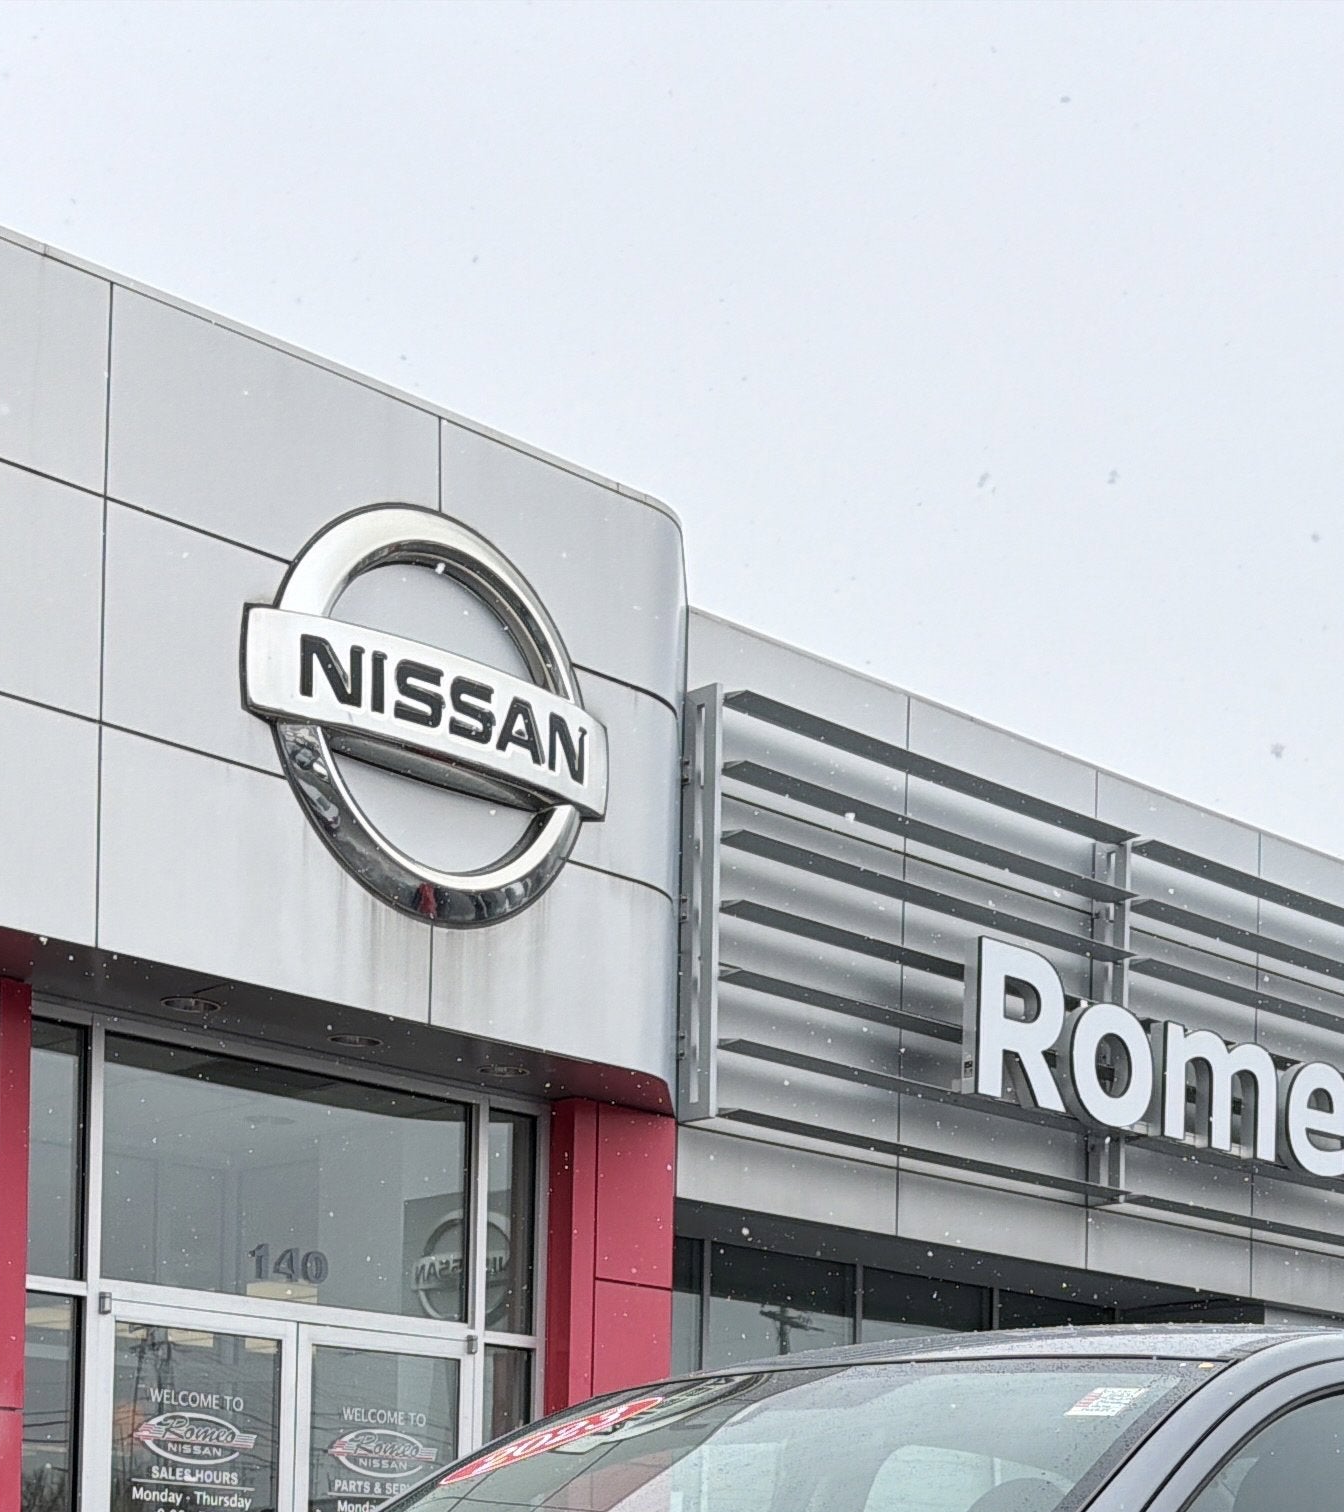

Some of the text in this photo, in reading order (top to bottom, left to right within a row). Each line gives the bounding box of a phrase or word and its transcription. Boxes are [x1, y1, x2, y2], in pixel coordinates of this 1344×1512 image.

[299, 633, 588, 786] NISSAN
[249, 1243, 329, 1285] 140
[149, 1387, 244, 1412] WELCOME TO
[156, 1414, 237, 1444] Romeo
[342, 1406, 426, 1427] WELCOME TO
[167, 1442, 222, 1457] NISSAN
[351, 1431, 420, 1458] Romeo
[151, 1465, 239, 1486] SALES HOURS
[358, 1458, 408, 1471] NISSAN
[131, 1486, 183, 1506] Monday
[194, 1490, 252, 1511] Thursday
[334, 1479, 371, 1494] PARTS
[373, 1481, 382, 1494] &
